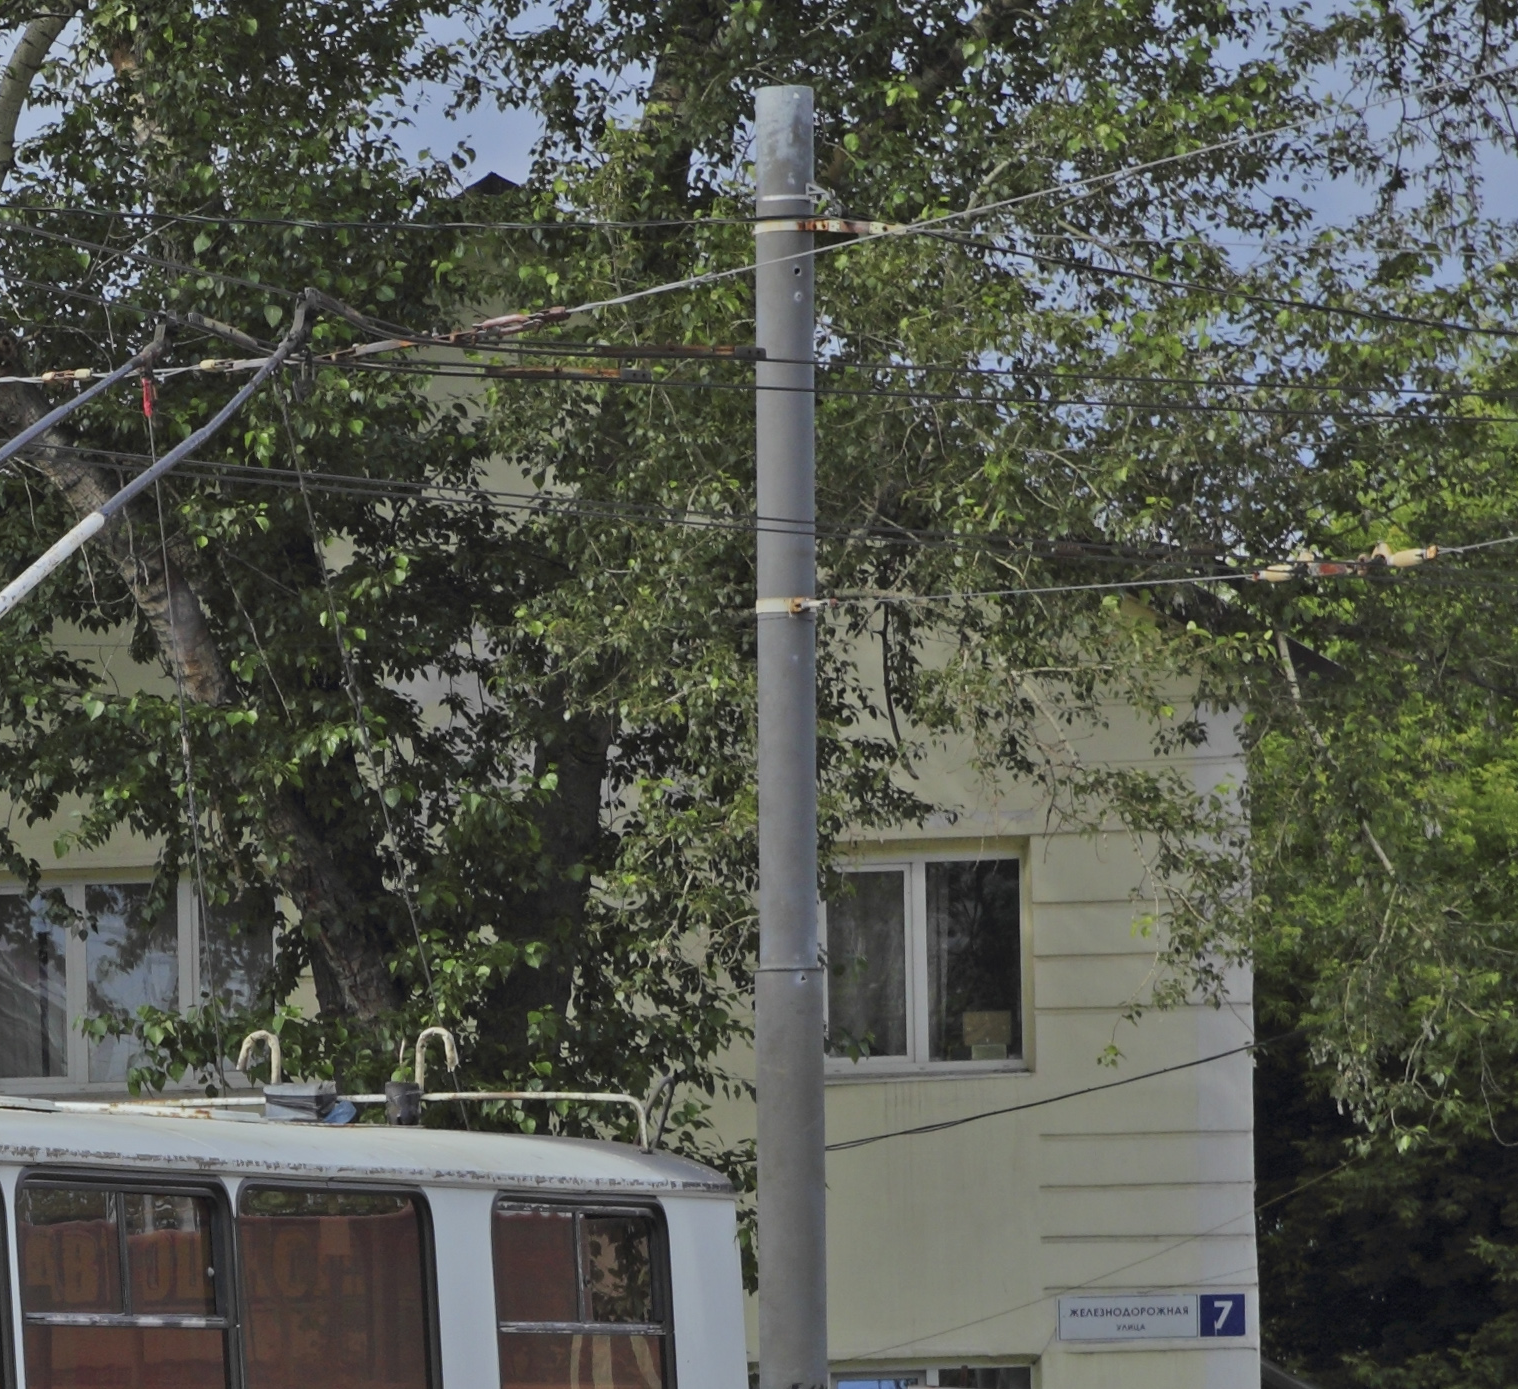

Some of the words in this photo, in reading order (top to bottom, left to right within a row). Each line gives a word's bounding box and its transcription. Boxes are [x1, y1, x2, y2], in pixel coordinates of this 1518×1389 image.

[1069, 1306, 1189, 1318] ЖЕЛЕЗНОДОРОЖНАЯ
[1213, 1300, 1234, 1329] 7
[1115, 1323, 1146, 1331] УЛИЦА
